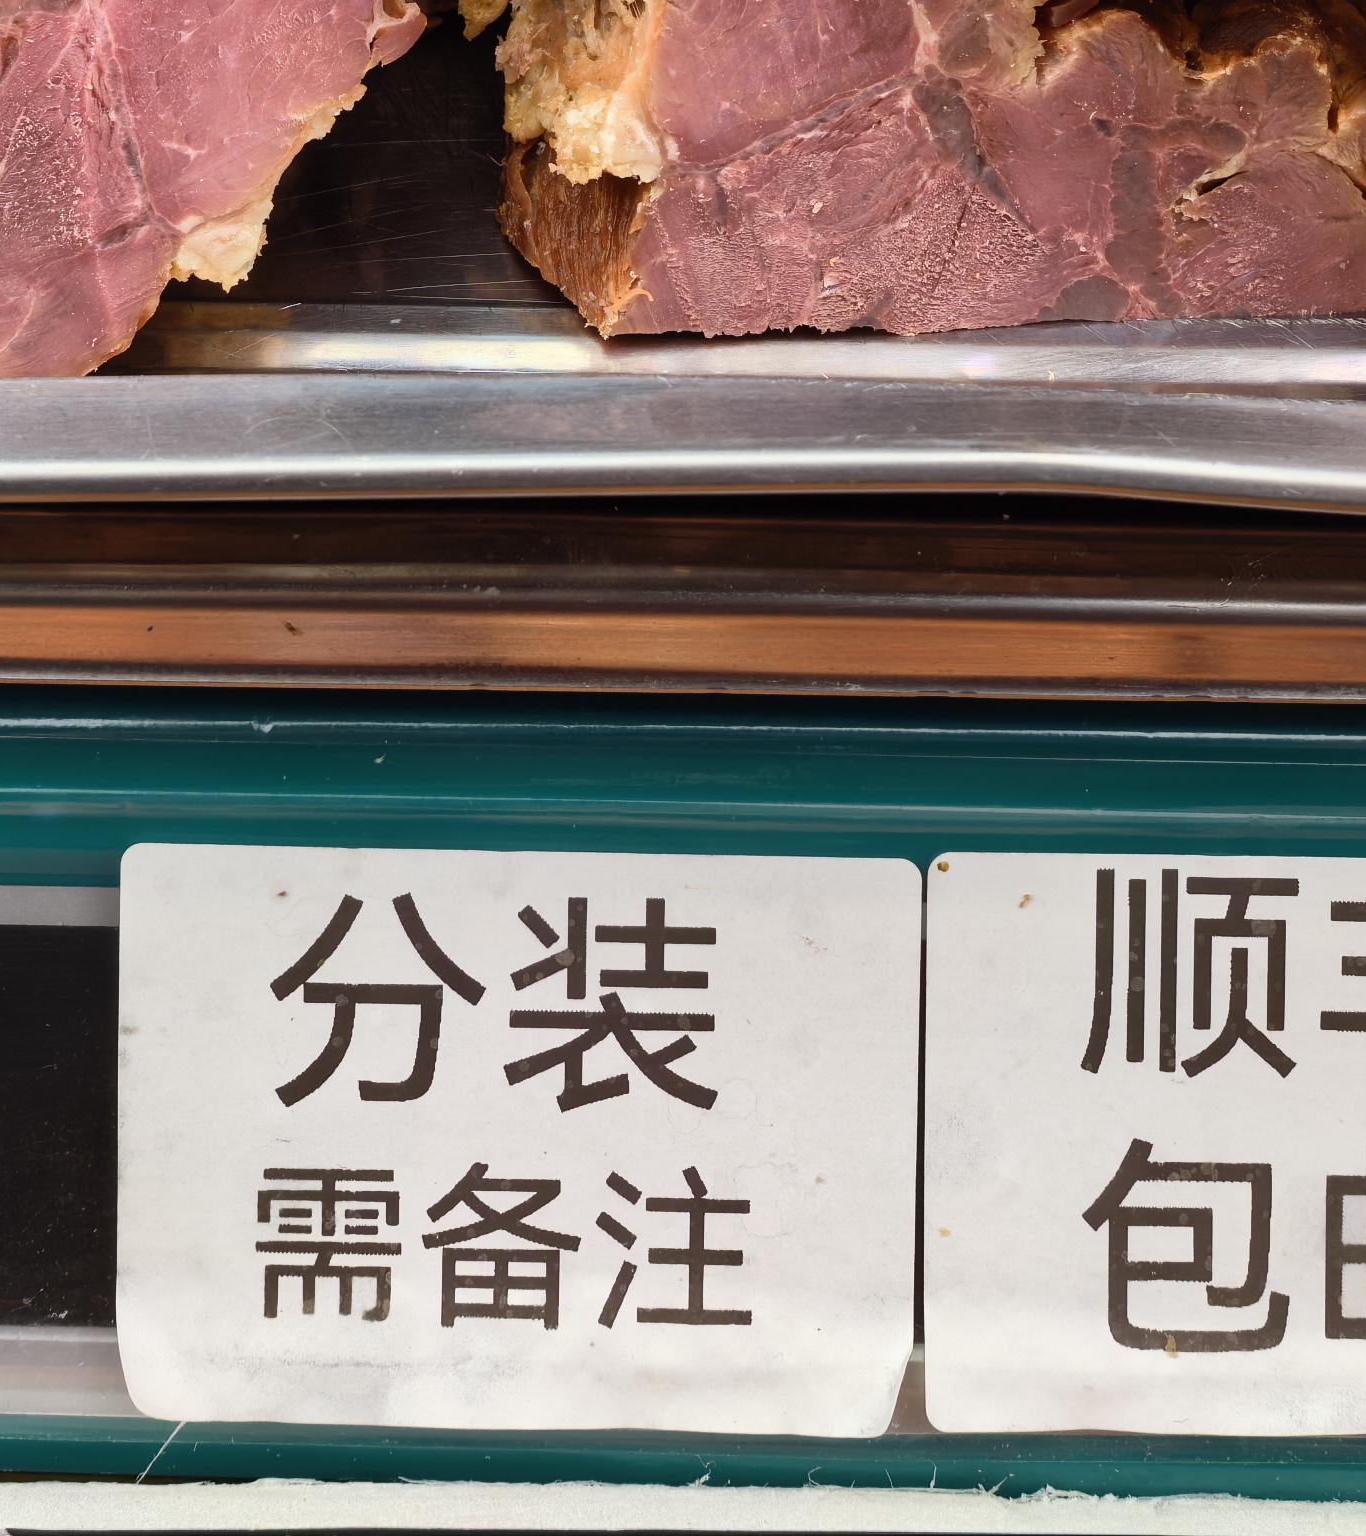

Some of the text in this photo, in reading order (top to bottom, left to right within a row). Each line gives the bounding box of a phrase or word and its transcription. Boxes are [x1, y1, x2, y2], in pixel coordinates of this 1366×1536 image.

[269, 892, 719, 1114] 分装
[255, 1161, 753, 1331] 需备注
